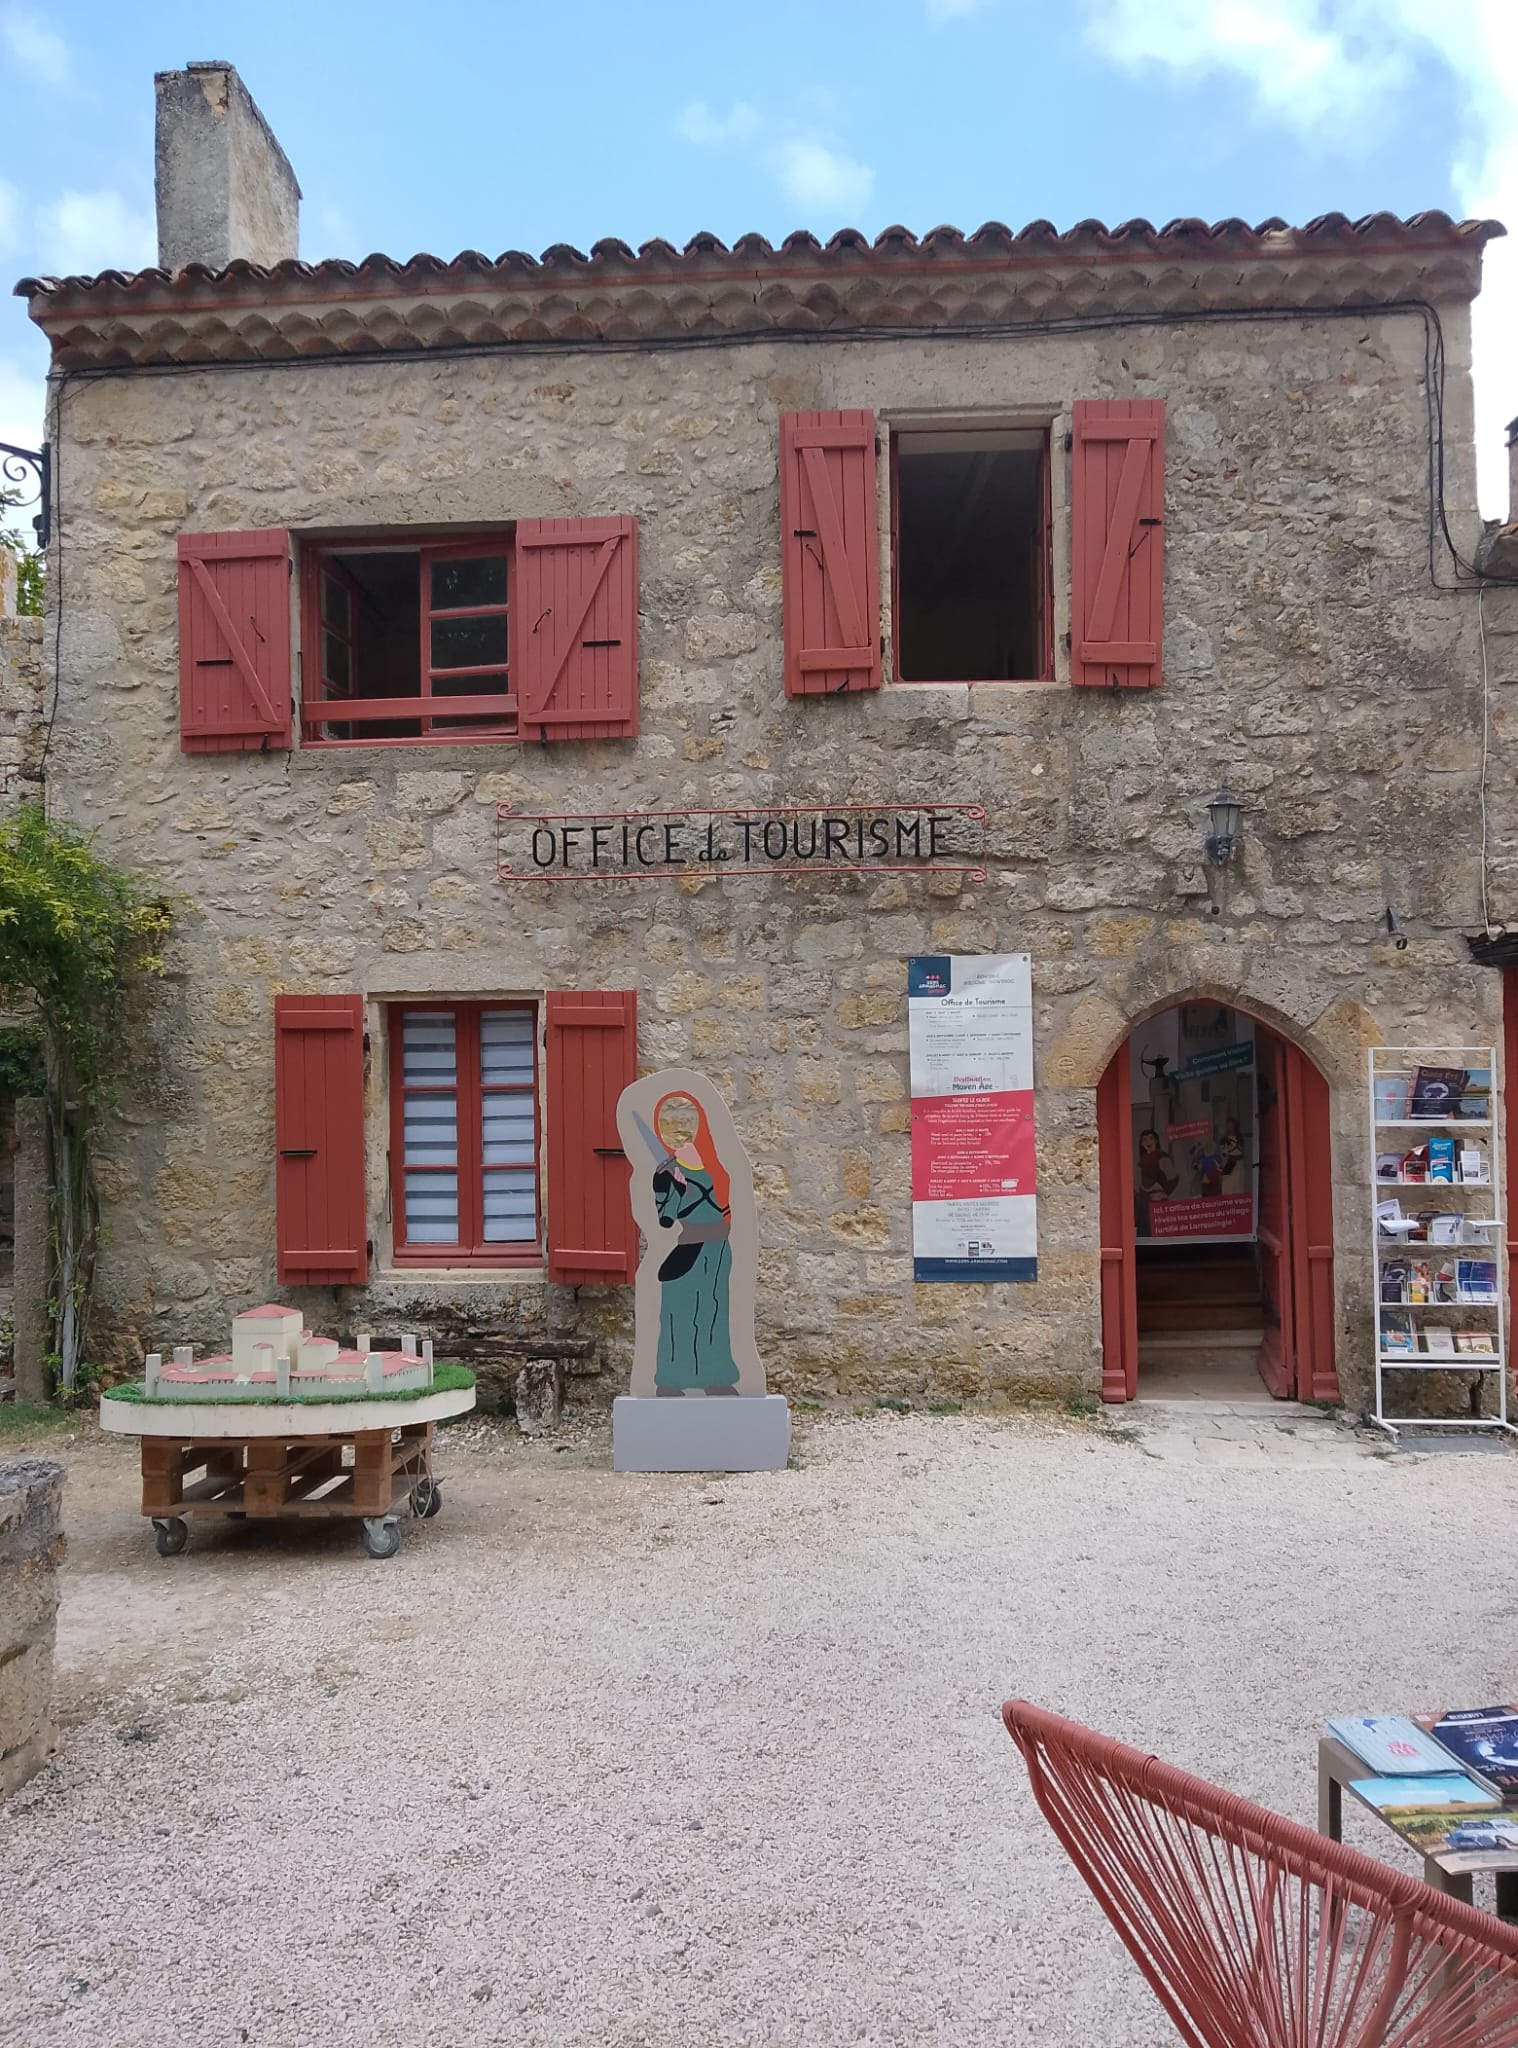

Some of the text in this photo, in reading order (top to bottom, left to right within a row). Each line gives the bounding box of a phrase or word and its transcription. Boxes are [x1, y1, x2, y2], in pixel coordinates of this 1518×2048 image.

[532, 816, 954, 867] OFFICE de TOURISME
[940, 997, 1006, 1007] Office de Tourisme
